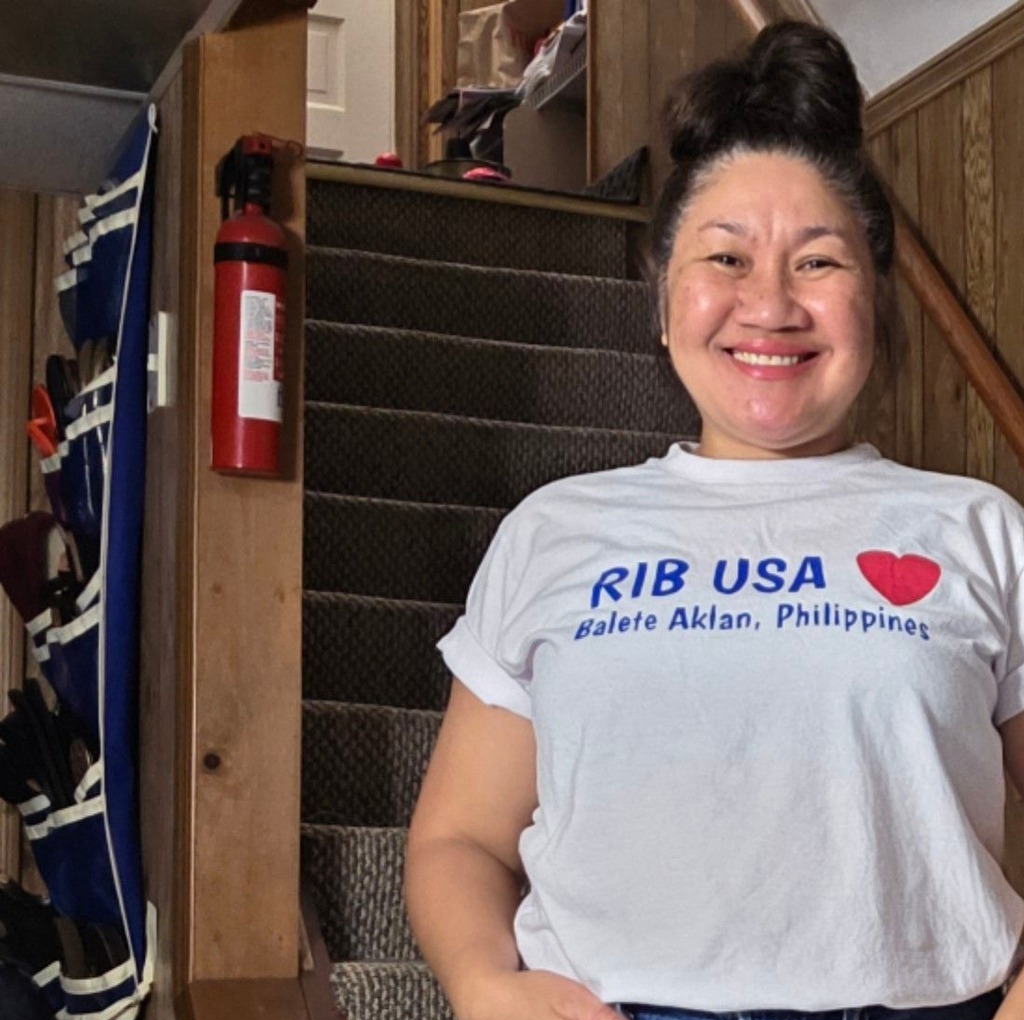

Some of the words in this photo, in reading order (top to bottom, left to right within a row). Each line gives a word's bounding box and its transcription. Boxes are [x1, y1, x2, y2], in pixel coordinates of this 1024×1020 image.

[591, 558, 689, 609] RIB
[713, 556, 826, 595] USA
[574, 608, 657, 641] Balete
[669, 605, 760, 632] Aklan,
[777, 604, 930, 641] Philippines
